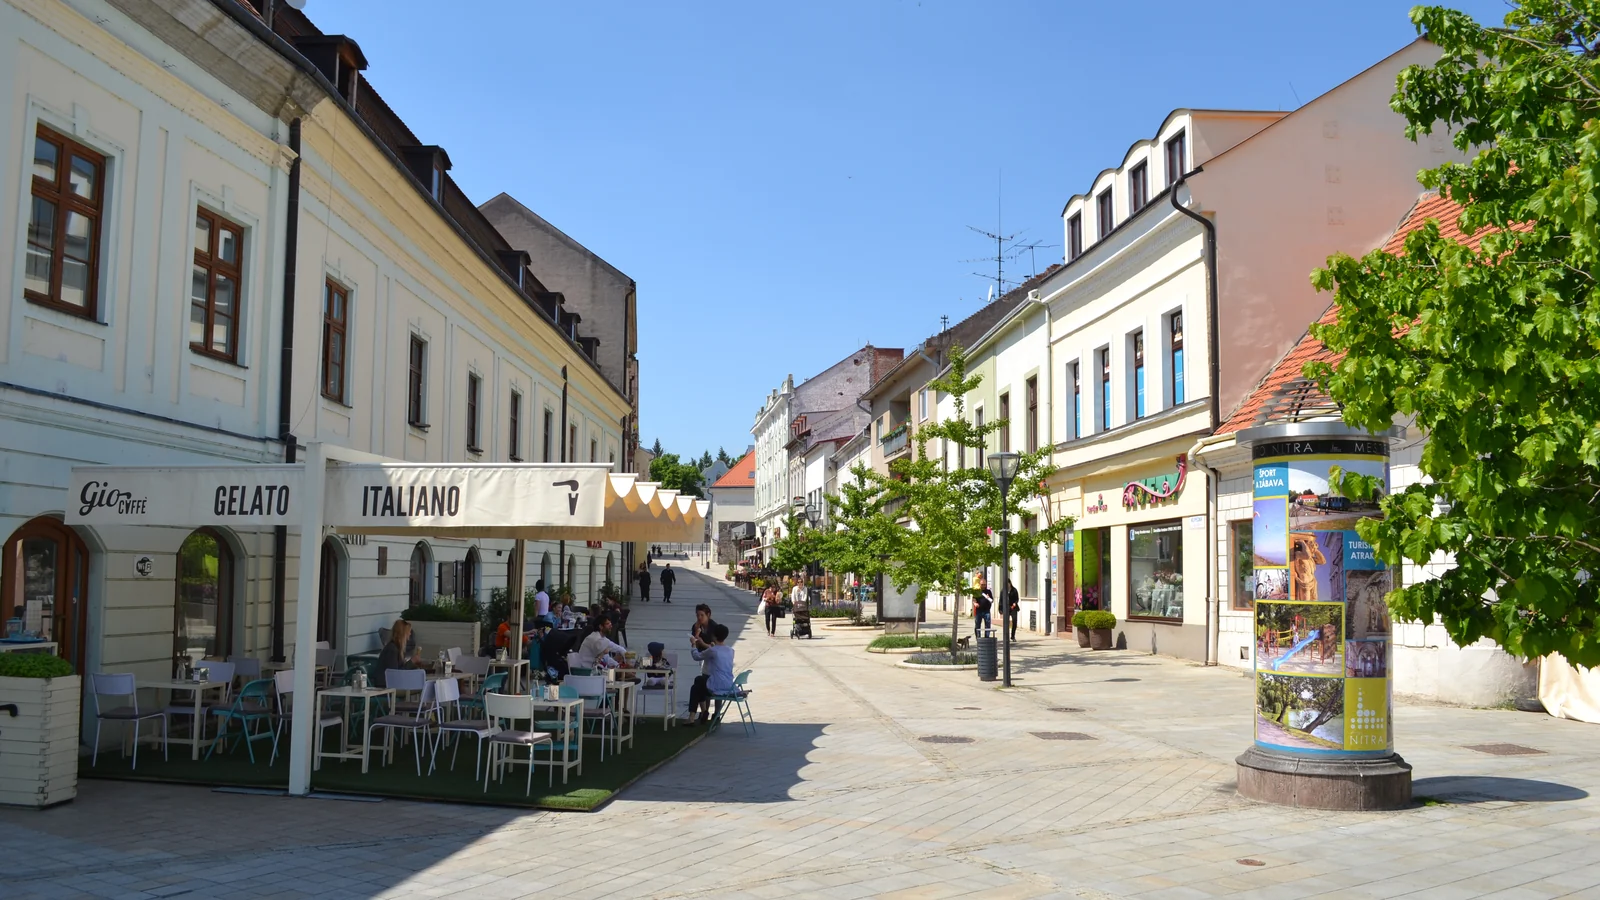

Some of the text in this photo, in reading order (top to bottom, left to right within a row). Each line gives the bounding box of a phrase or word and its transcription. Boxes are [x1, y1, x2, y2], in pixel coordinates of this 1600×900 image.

[1272, 442, 1313, 455] NITRA
[1259, 468, 1277, 479] ŠPORT
[1260, 478, 1284, 489] ZÁBAVA
[79, 481, 131, 516] Gio
[214, 484, 290, 517] GELATO
[362, 485, 460, 518] ITALIANO
[1350, 551, 1375, 560] ATRAK
[1350, 735, 1383, 745] NITRA
